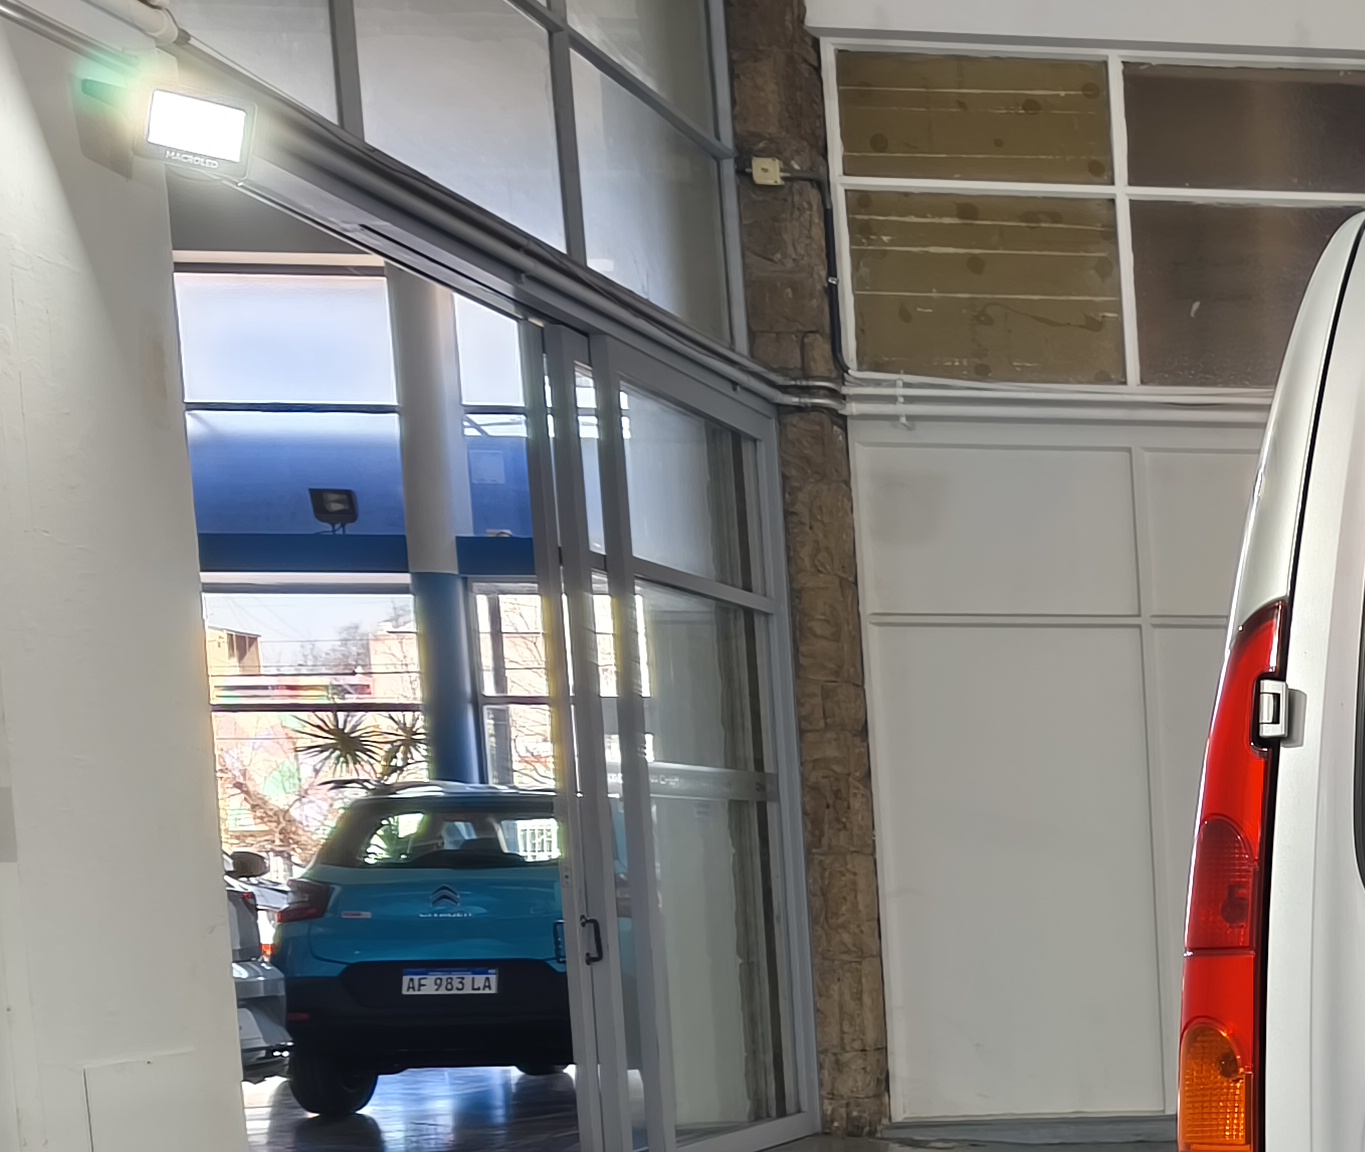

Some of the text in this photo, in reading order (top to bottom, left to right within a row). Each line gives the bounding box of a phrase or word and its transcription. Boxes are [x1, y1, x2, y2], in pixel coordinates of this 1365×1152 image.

[406, 976, 493, 993] AF 983 LA
